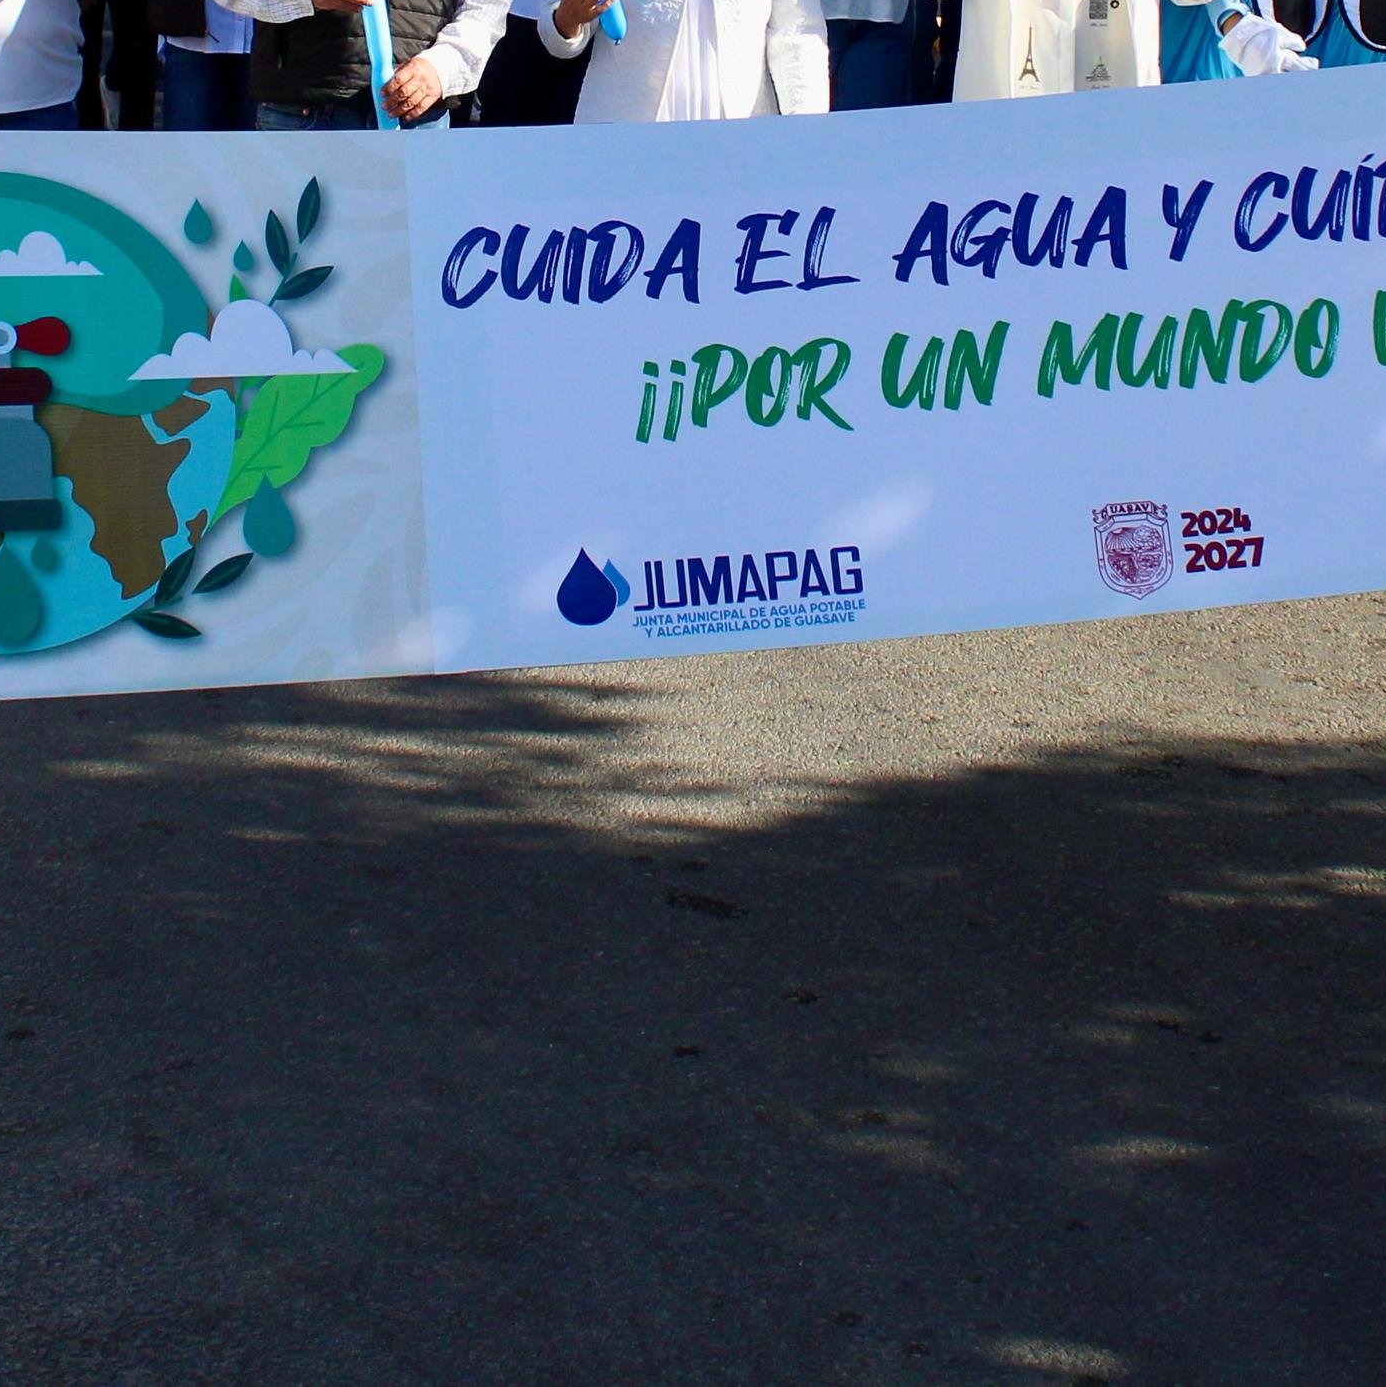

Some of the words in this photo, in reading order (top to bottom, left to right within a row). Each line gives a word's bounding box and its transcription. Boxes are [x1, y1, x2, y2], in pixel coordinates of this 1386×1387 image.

[441, 217, 702, 310] CUIDA
[732, 206, 861, 295] EL
[892, 184, 1128, 287] AGUA
[1161, 178, 1214, 263] Y
[880, 319, 1011, 412] UN
[1036, 297, 1341, 400] MUNDO
[1180, 507, 1252, 539] 2024
[1183, 536, 1265, 574] 2027
[633, 545, 864, 612] JUMAPAG
[632, 614, 674, 628] JUNTA
[676, 607, 747, 625] MUNICIPAL
[749, 607, 767, 618] DE
[769, 603, 808, 617] AGUA
[809, 598, 866, 614] POTABLE
[644, 627, 655, 639] Y
[656, 618, 772, 638] ALCANTARILLADO
[774, 616, 792, 629] DE
[794, 612, 855, 628] GUASAVE
